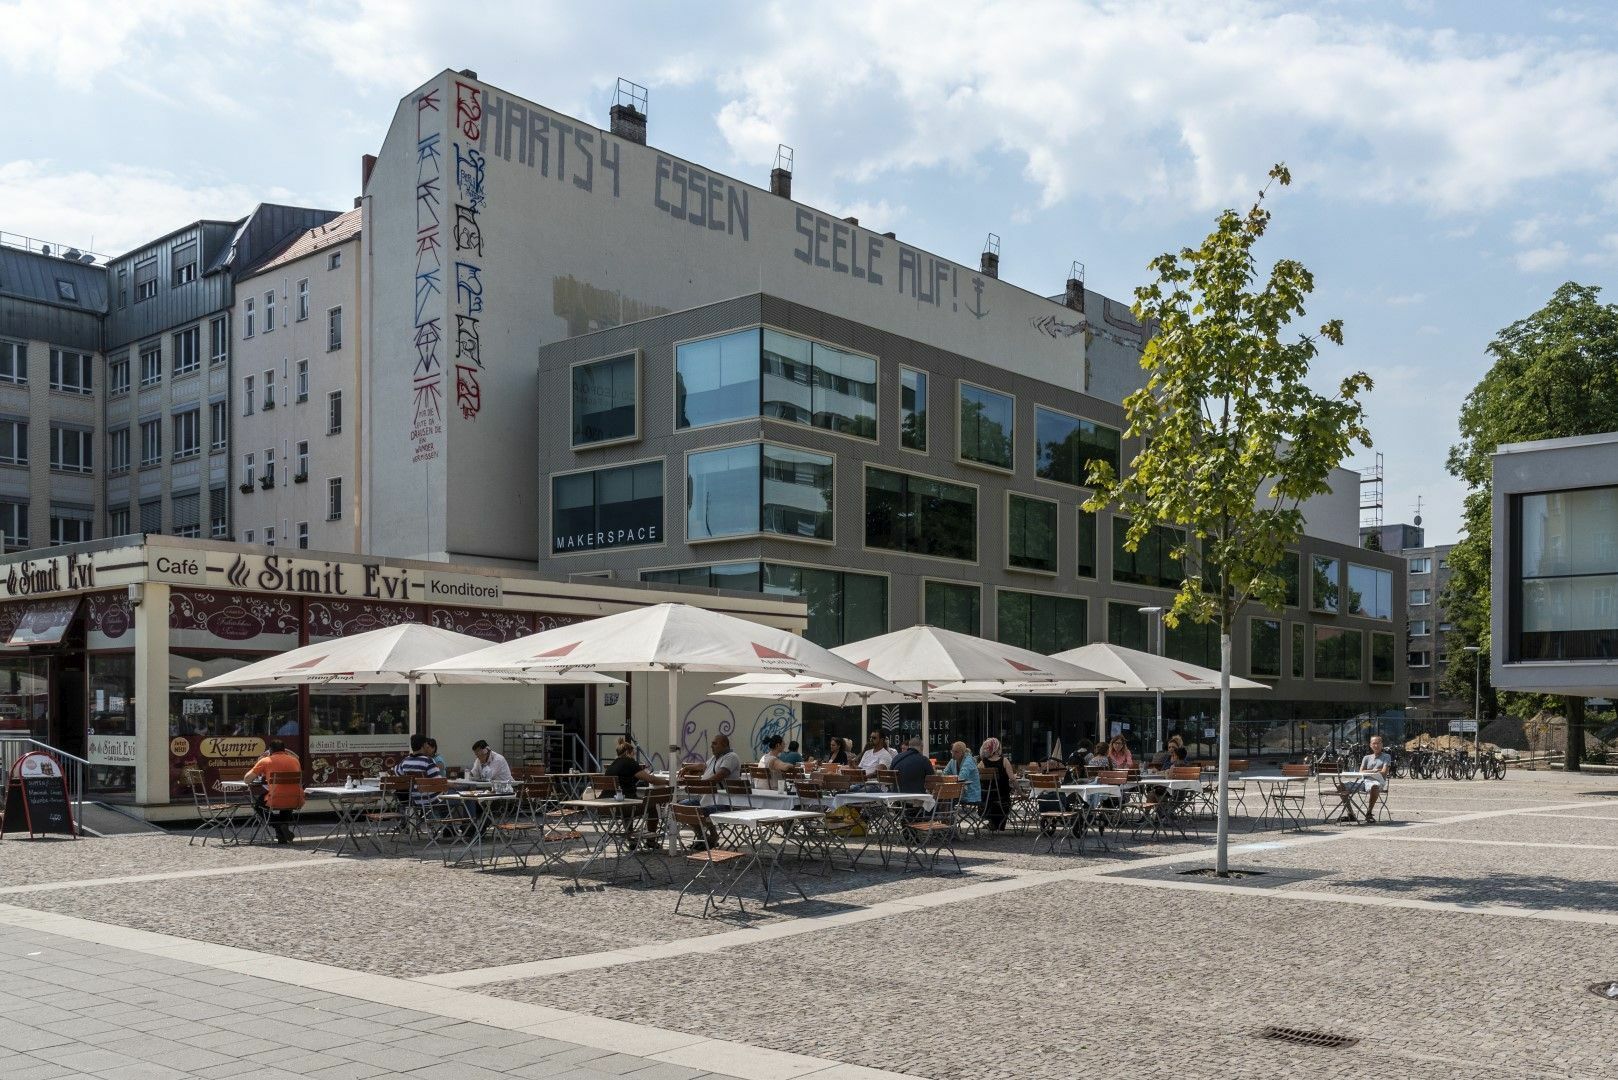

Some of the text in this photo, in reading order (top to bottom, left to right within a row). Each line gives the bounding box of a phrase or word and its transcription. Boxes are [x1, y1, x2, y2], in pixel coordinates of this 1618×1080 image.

[654, 154, 749, 242] ESSEN
[794, 206, 884, 286] SEELE
[898, 247, 958, 313] AUF!
[556, 526, 656, 549] MAKERSPACE
[19, 552, 95, 595] Simit Evi
[156, 557, 199, 575] Café
[257, 555, 410, 600] Simit Evi
[431, 579, 499, 598] Konditorei
[103, 740, 123, 755] Simit
[209, 738, 258, 757] Kumpir
